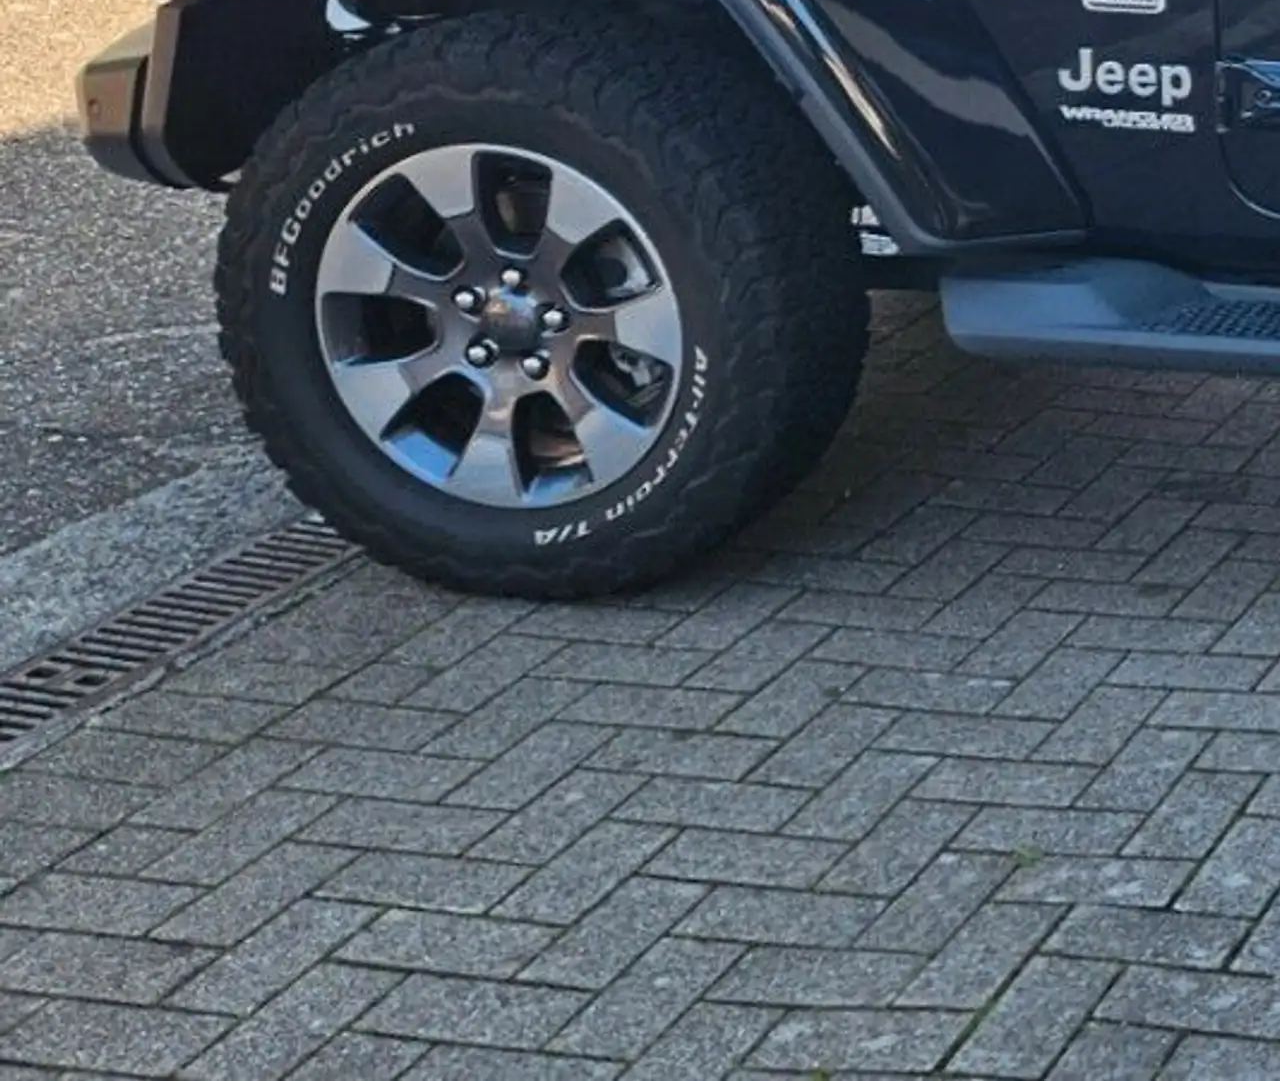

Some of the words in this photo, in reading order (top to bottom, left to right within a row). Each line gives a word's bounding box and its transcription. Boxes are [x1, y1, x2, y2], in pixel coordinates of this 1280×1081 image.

[1058, 47, 1192, 107] Jeep
[269, 122, 415, 296] BFGoodrich
[534, 520, 591, 545] T/A
